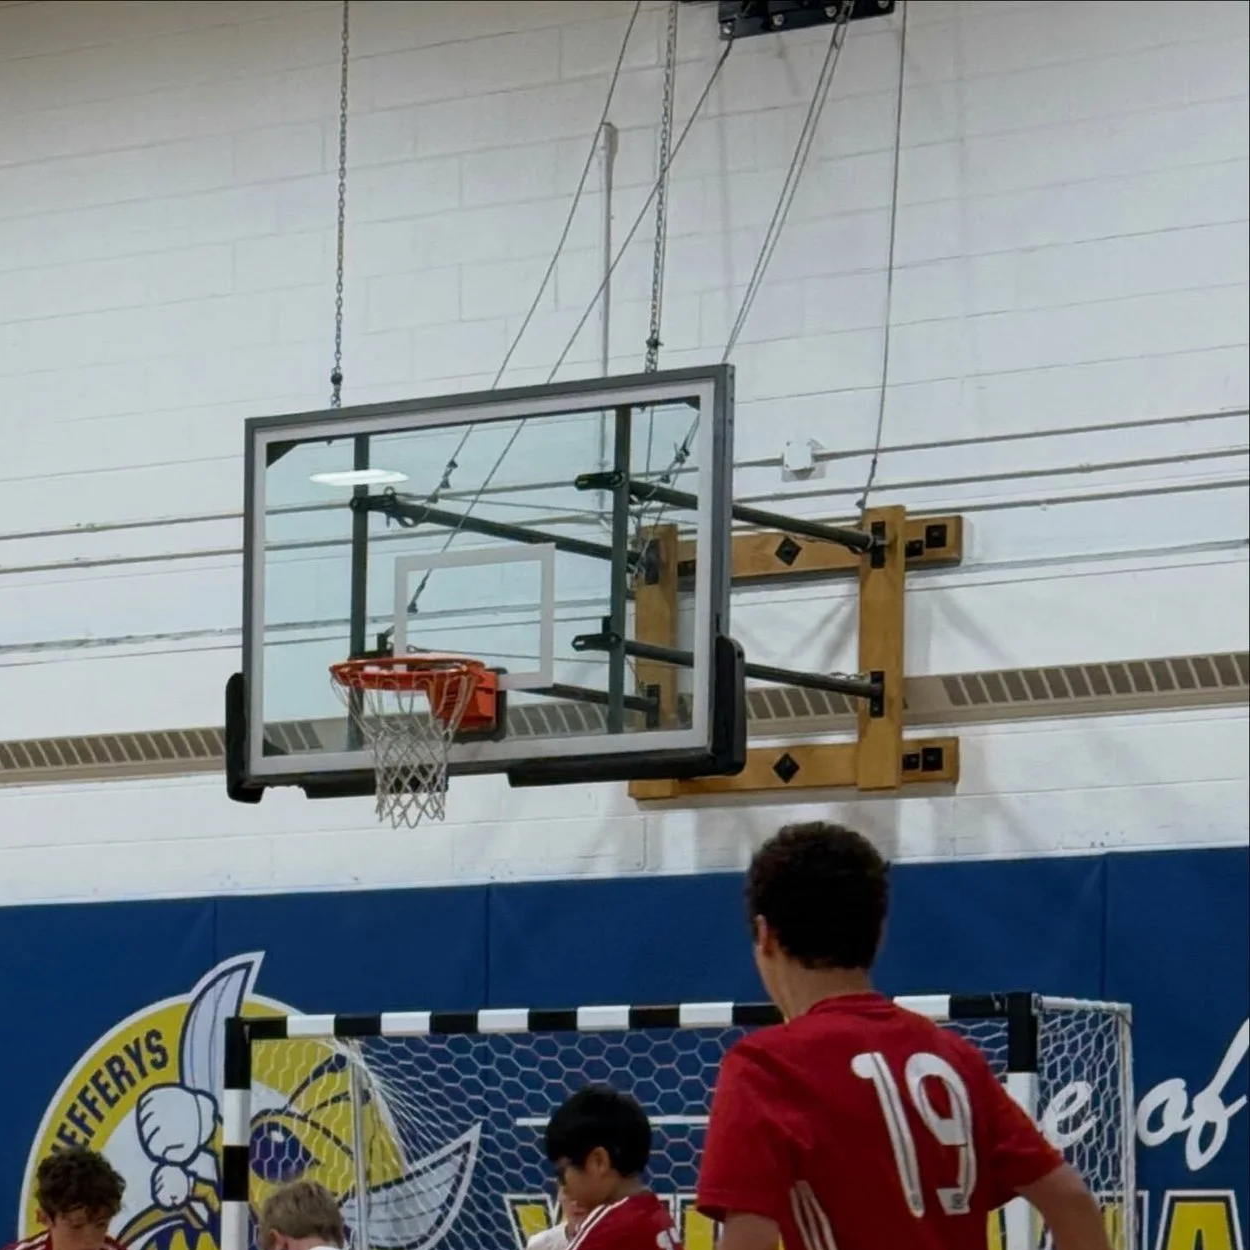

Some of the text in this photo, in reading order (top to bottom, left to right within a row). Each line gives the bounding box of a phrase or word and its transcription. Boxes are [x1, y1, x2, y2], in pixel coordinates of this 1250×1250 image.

[50, 1029, 169, 1152] EFFERYS
[851, 1052, 977, 1218] 19
[1136, 1018, 1249, 1171] of
